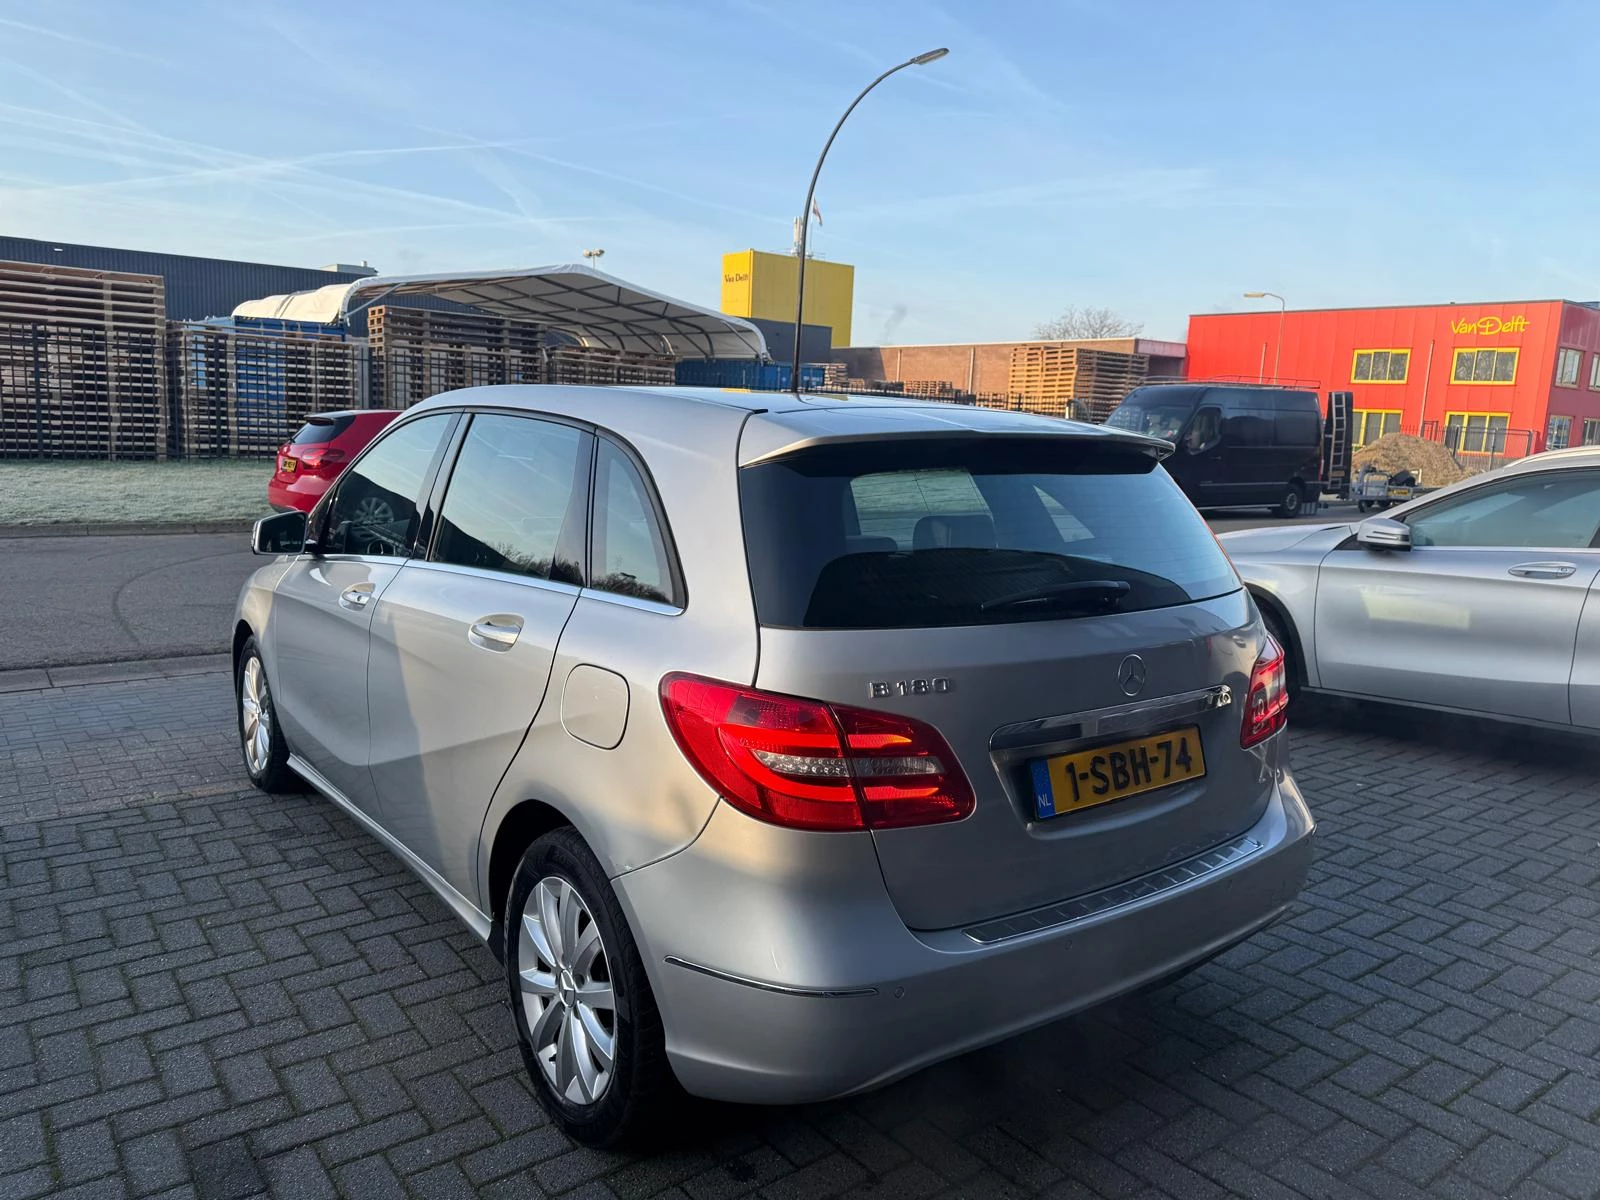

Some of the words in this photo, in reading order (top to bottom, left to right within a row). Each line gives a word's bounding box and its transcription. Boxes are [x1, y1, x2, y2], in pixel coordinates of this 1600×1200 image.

[1450, 317, 1477, 335] Van
[1477, 315, 1530, 336] Delft
[1066, 737, 1193, 802] 1-SBH-74
[1038, 796, 1052, 807] NL
